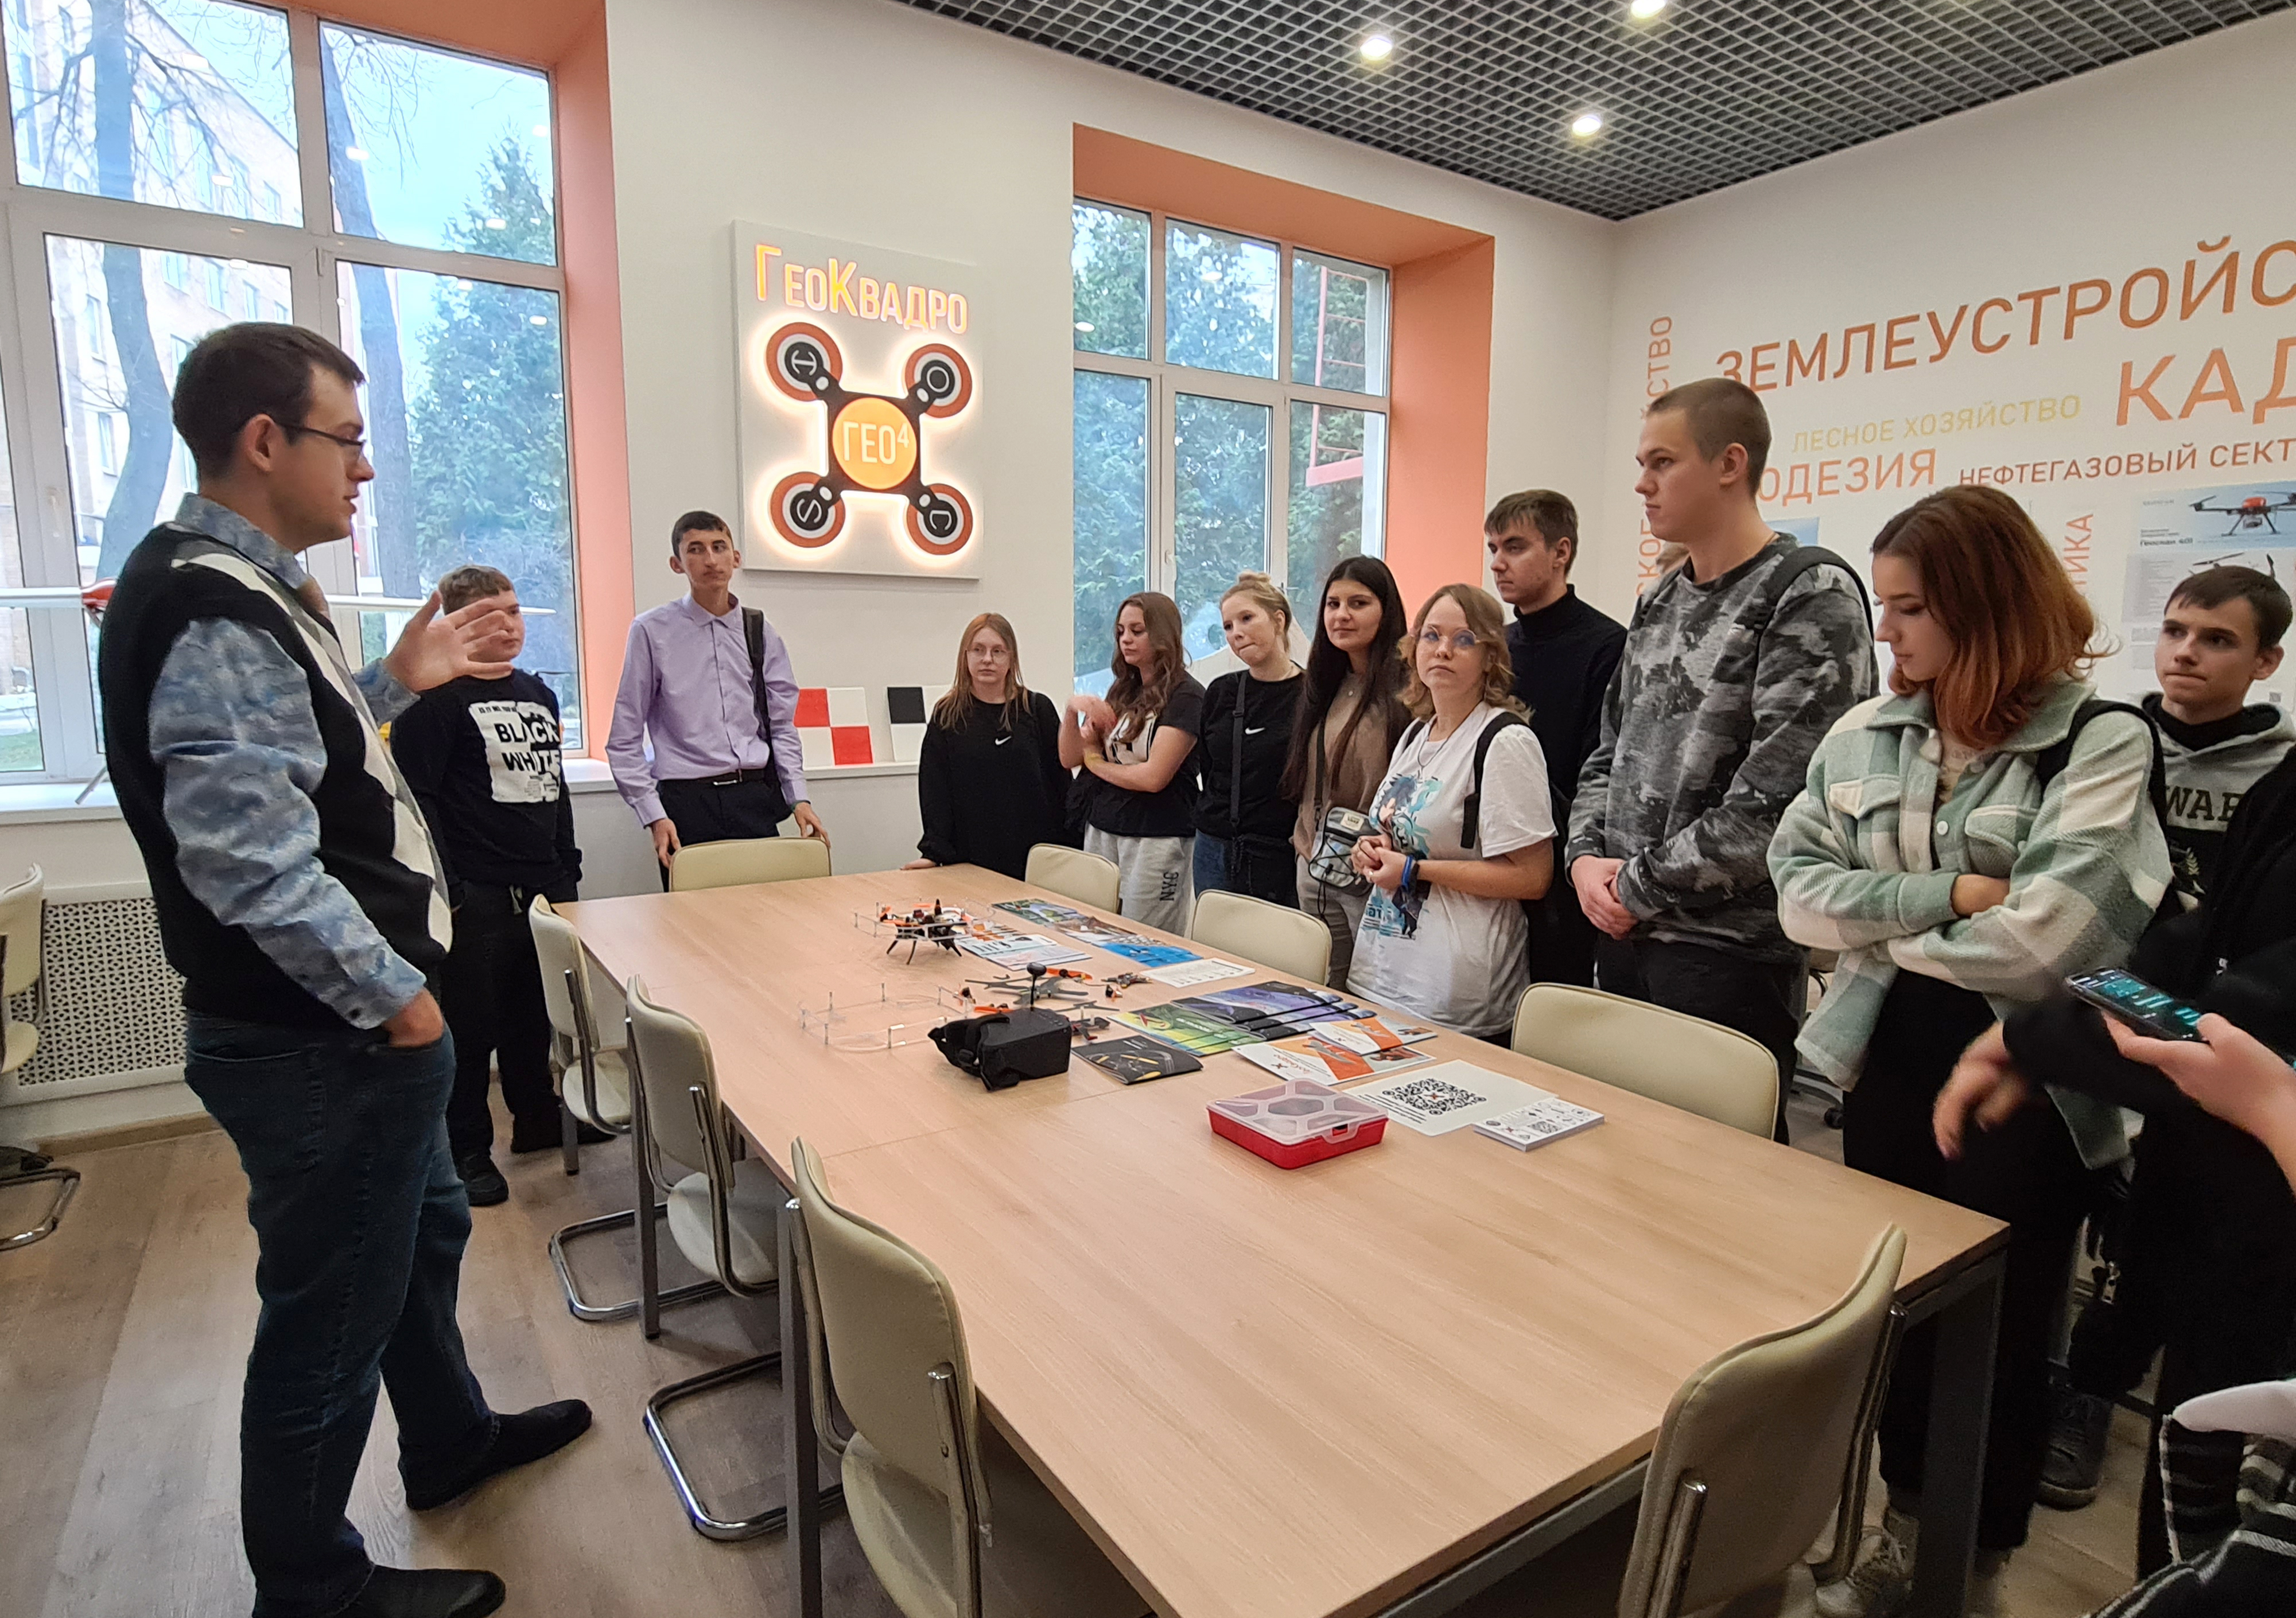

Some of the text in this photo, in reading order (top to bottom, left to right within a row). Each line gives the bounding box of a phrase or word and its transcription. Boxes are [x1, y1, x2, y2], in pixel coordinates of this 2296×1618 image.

[1716, 235, 2296, 392] ЗЕМЛЕУСТРОЙС
[1641, 316, 1672, 417] СТВО
[1793, 394, 2081, 453] ЛЕСНОЕ ХОЗЯЙСТВО
[1758, 448, 1936, 507] ОДЕЗИЯ
[1959, 438, 2296, 485] НЕФТЕГАЗОВЫЙ СЕКТ
[494, 721, 561, 743] BLACK
[502, 749, 561, 772] WHITE
[1160, 872, 1179, 901] NYC
